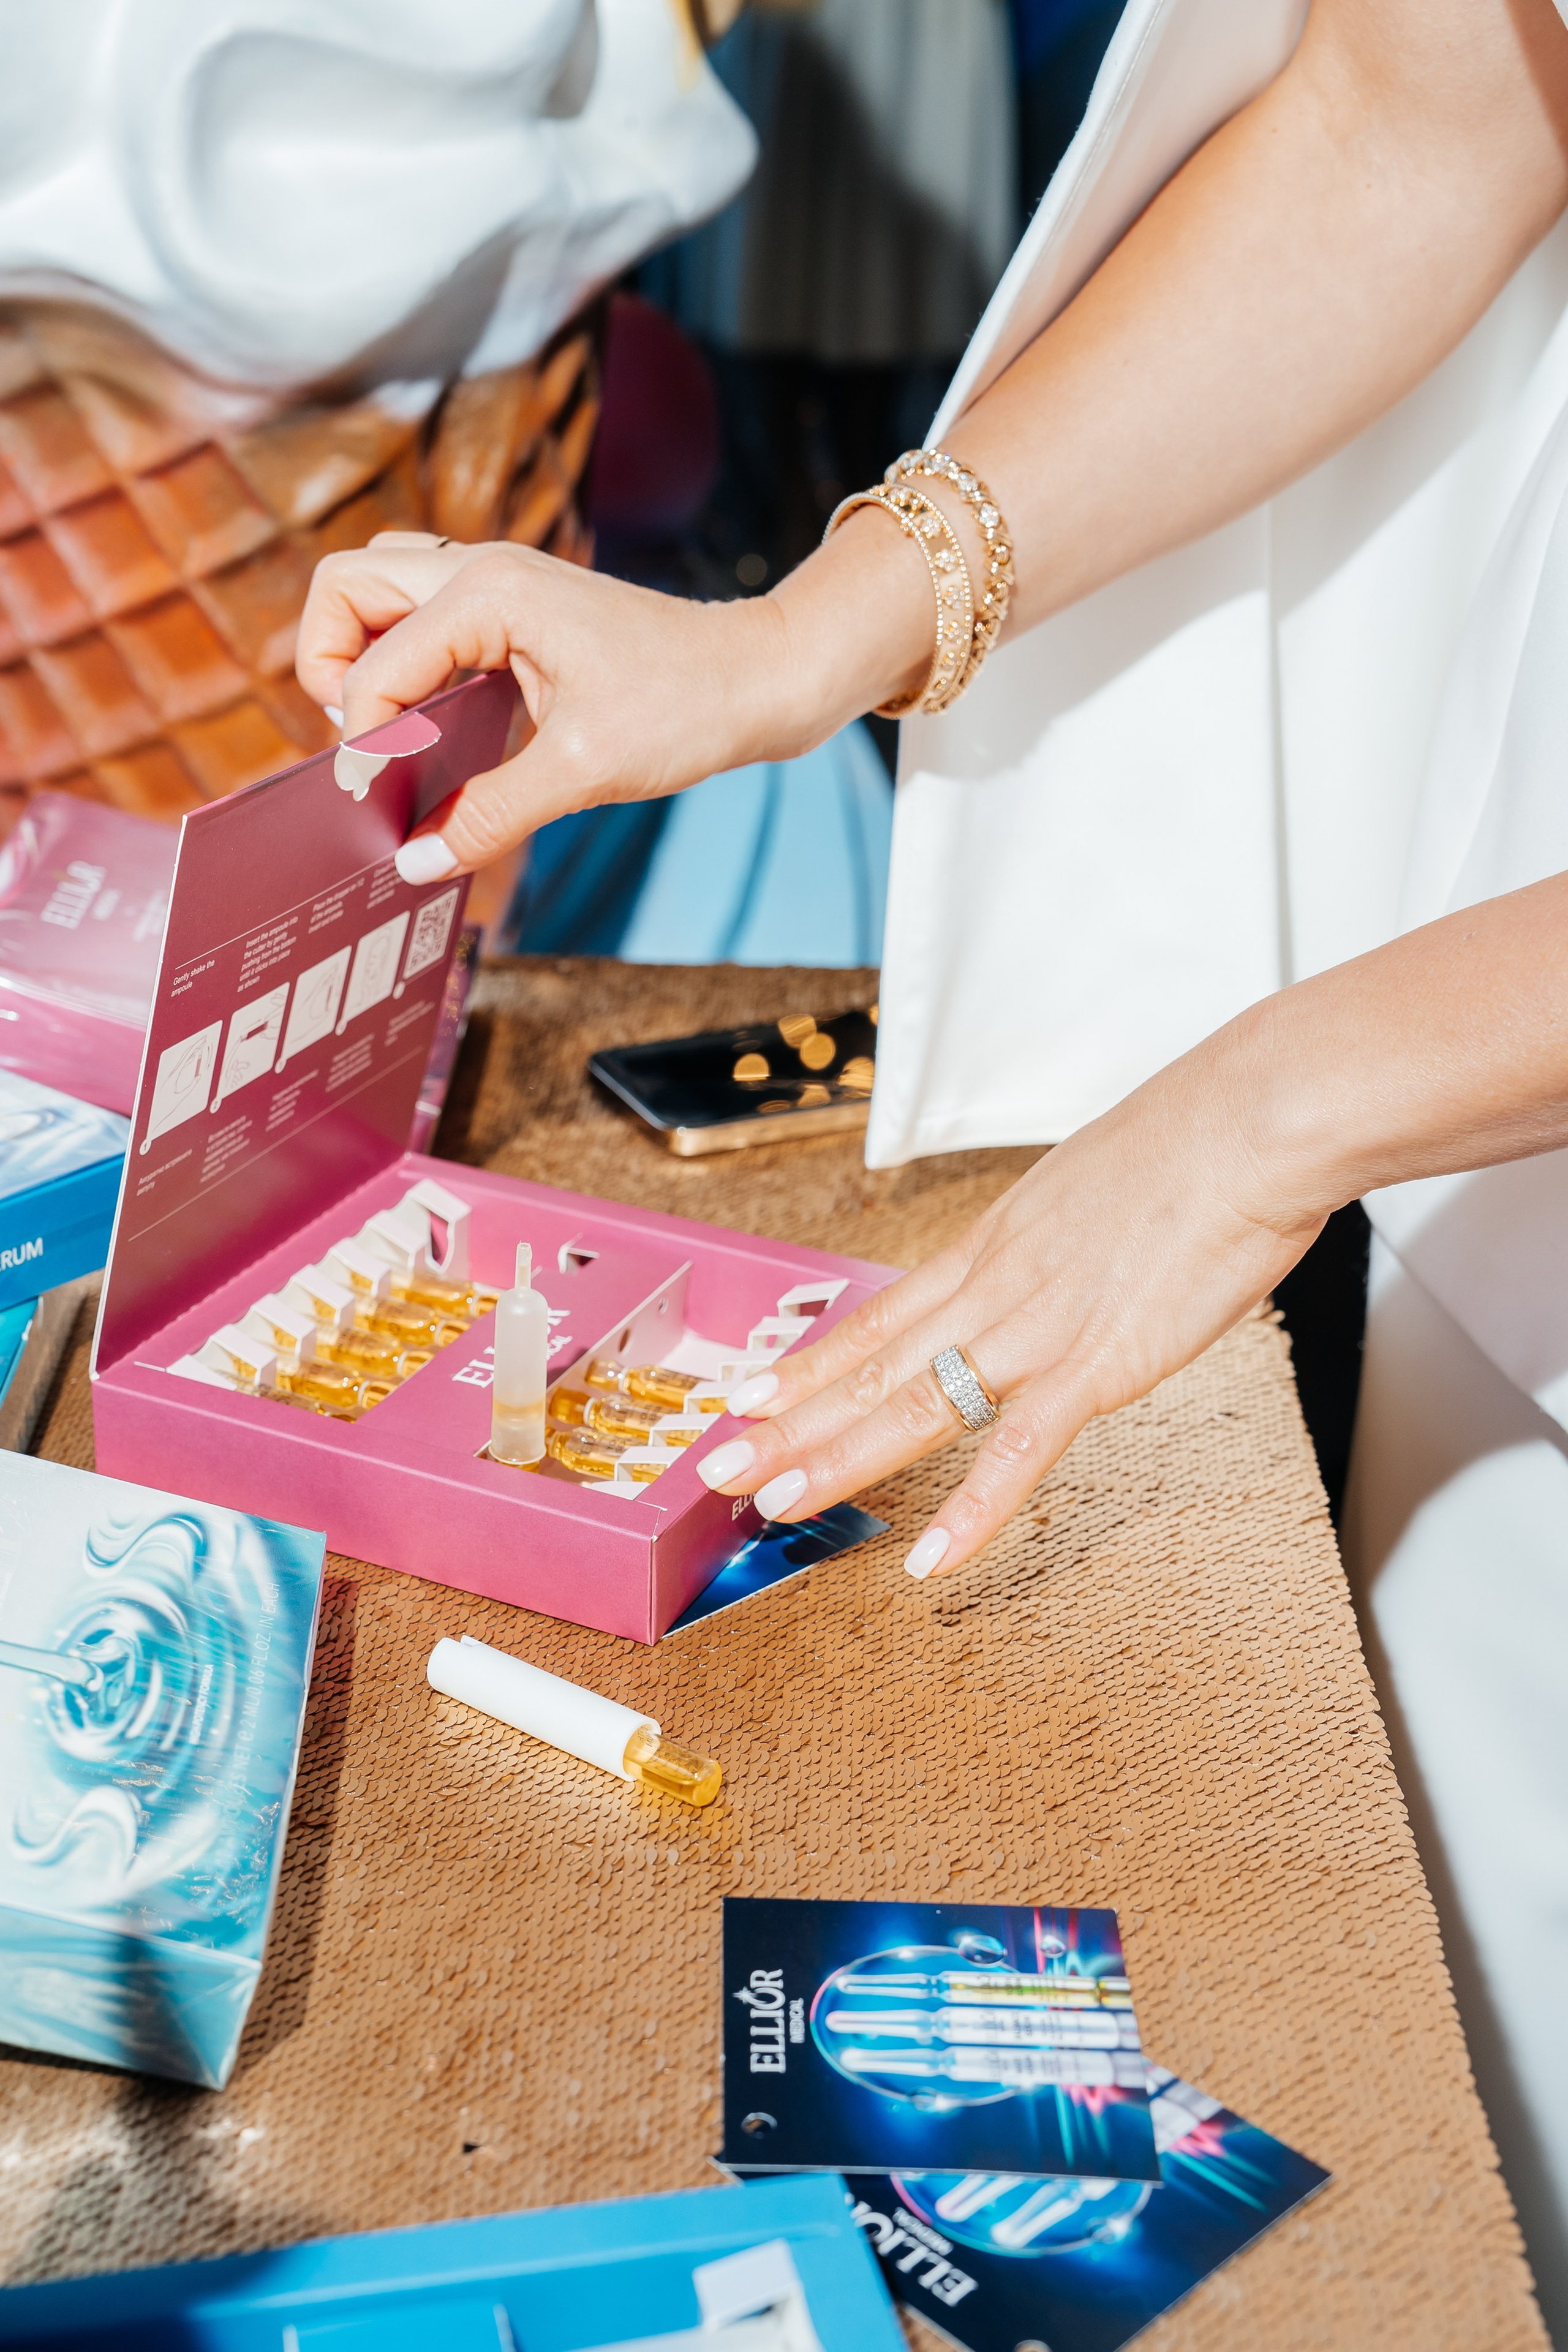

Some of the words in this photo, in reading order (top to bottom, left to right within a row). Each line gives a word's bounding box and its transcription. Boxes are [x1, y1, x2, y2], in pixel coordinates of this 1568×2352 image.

[171, 981, 193, 998] ampoule
[173, 972, 190, 986] Gently
[190, 964, 206, 977] shake
[206, 960, 215, 969] the
[0, 1237, 43, 1272] RUM
[261, 1581, 281, 1614] EACH
[258, 1615, 274, 1629] IN
[750, 1969, 786, 2074] ELLIOR
[790, 1997, 805, 2044] MEDICAL
